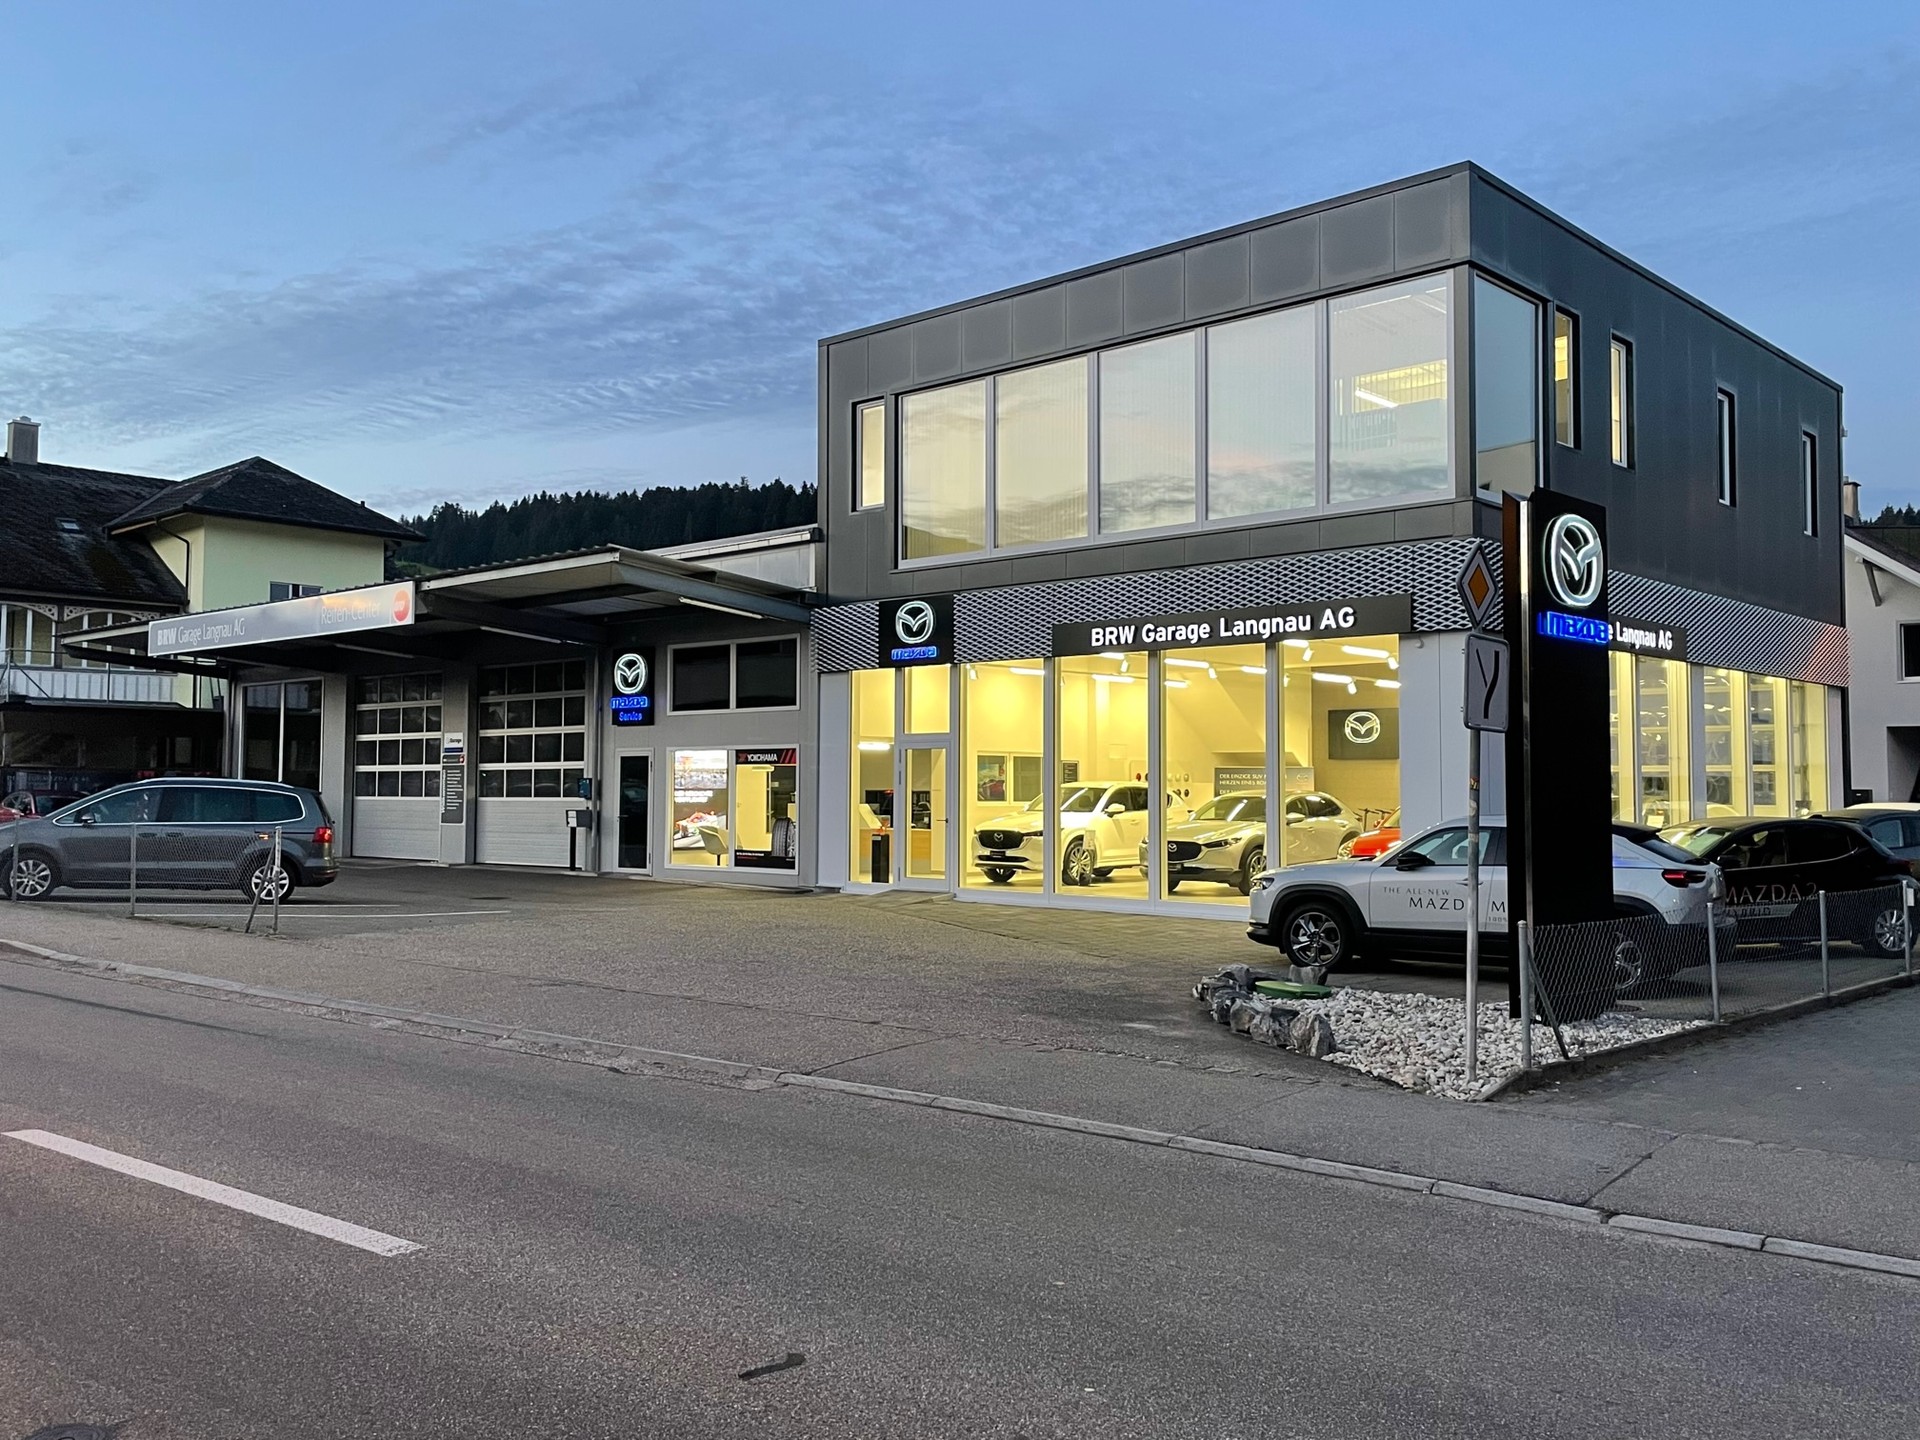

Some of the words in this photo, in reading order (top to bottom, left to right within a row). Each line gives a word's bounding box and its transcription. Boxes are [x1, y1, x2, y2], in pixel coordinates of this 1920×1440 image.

[157, 628, 177, 646] BRW
[177, 625, 201, 646] Garage
[202, 622, 233, 644] Langnau
[233, 618, 246, 636] AG
[1090, 625, 1136, 648] BRW
[1141, 620, 1211, 644] Garage
[1219, 611, 1312, 640] Langnau
[1319, 606, 1355, 631] AG
[1543, 610, 1610, 644] mazda
[1615, 621, 1657, 650] Langnau
[1657, 629, 1674, 651] AG
[891, 645, 938, 660] mazda
[610, 696, 648, 709] mazda
[619, 712, 643, 722] Service
[747, 754, 778, 762] YOKOHAMA
[1383, 886, 1401, 894] THE
[1406, 887, 1450, 896] ALL-NEW
[1409, 896, 1465, 911] MAZD
